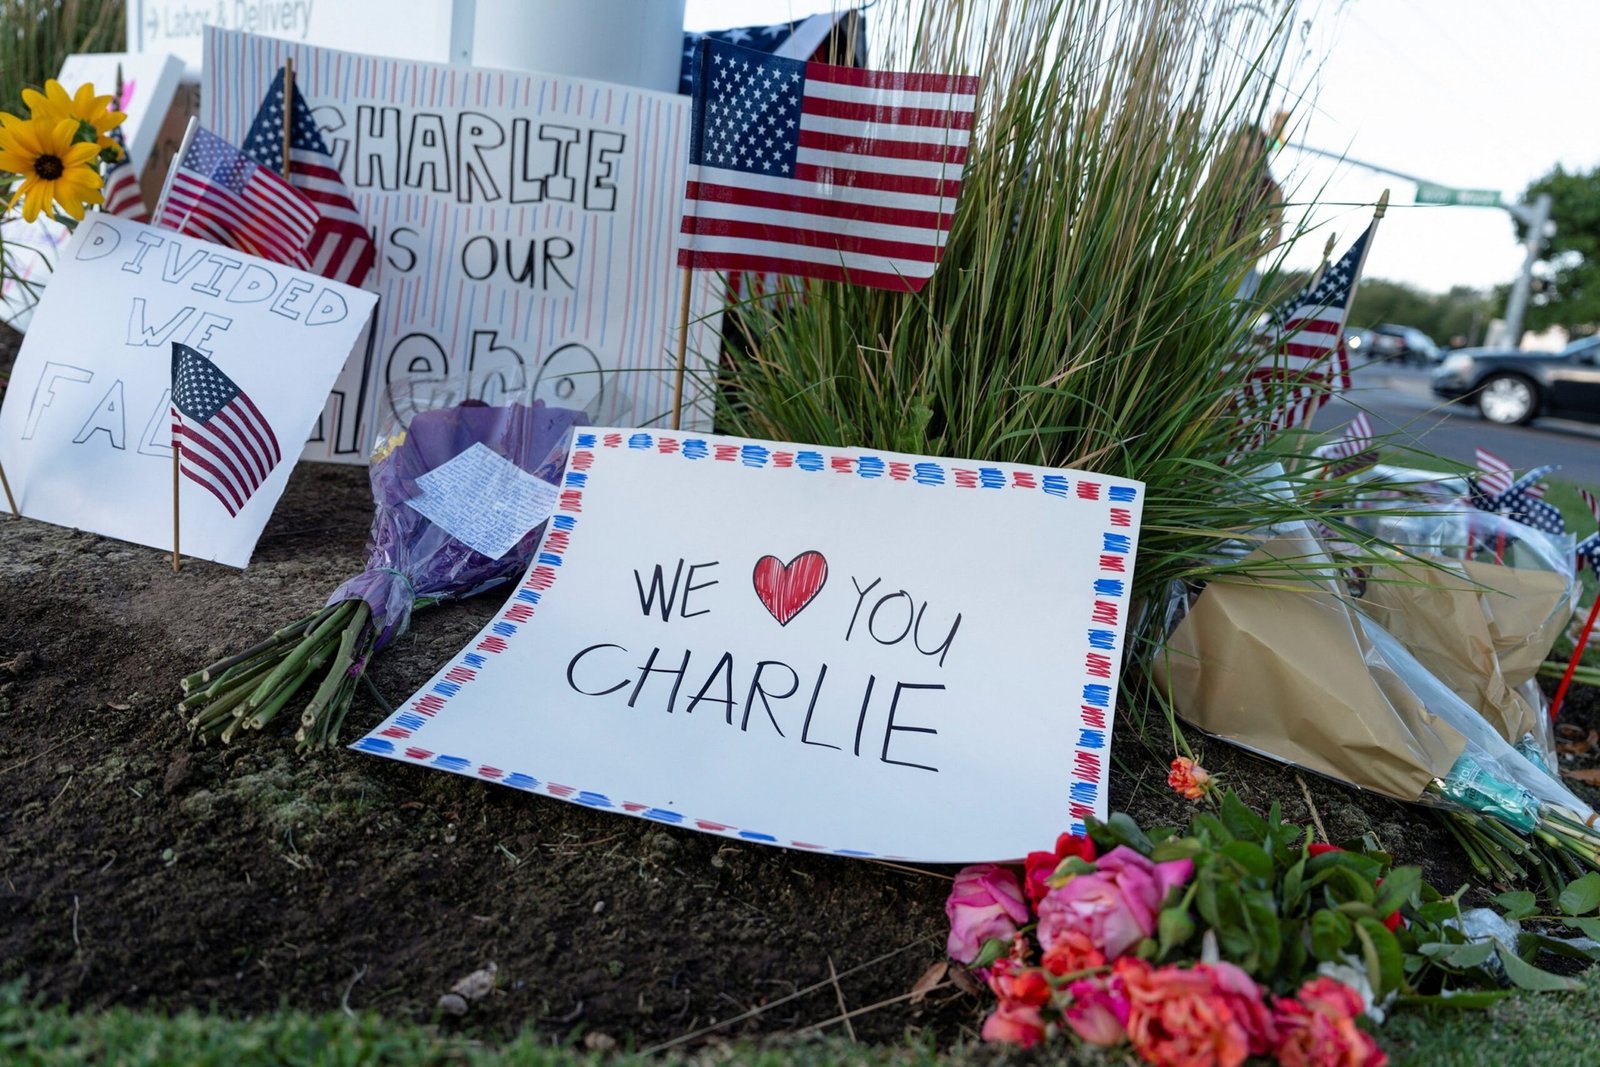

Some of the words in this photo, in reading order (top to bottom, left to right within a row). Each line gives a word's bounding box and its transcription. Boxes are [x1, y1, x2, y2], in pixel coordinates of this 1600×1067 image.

[233, 0, 313, 39] Delivery
[75, 221, 348, 326] DIVIDED
[461, 235, 575, 291] OUR
[126, 297, 233, 358] WE
[21, 362, 173, 459] FAL
[633, 558, 720, 623] WE
[845, 576, 962, 668] YOU
[566, 643, 946, 772] CHARLIE
